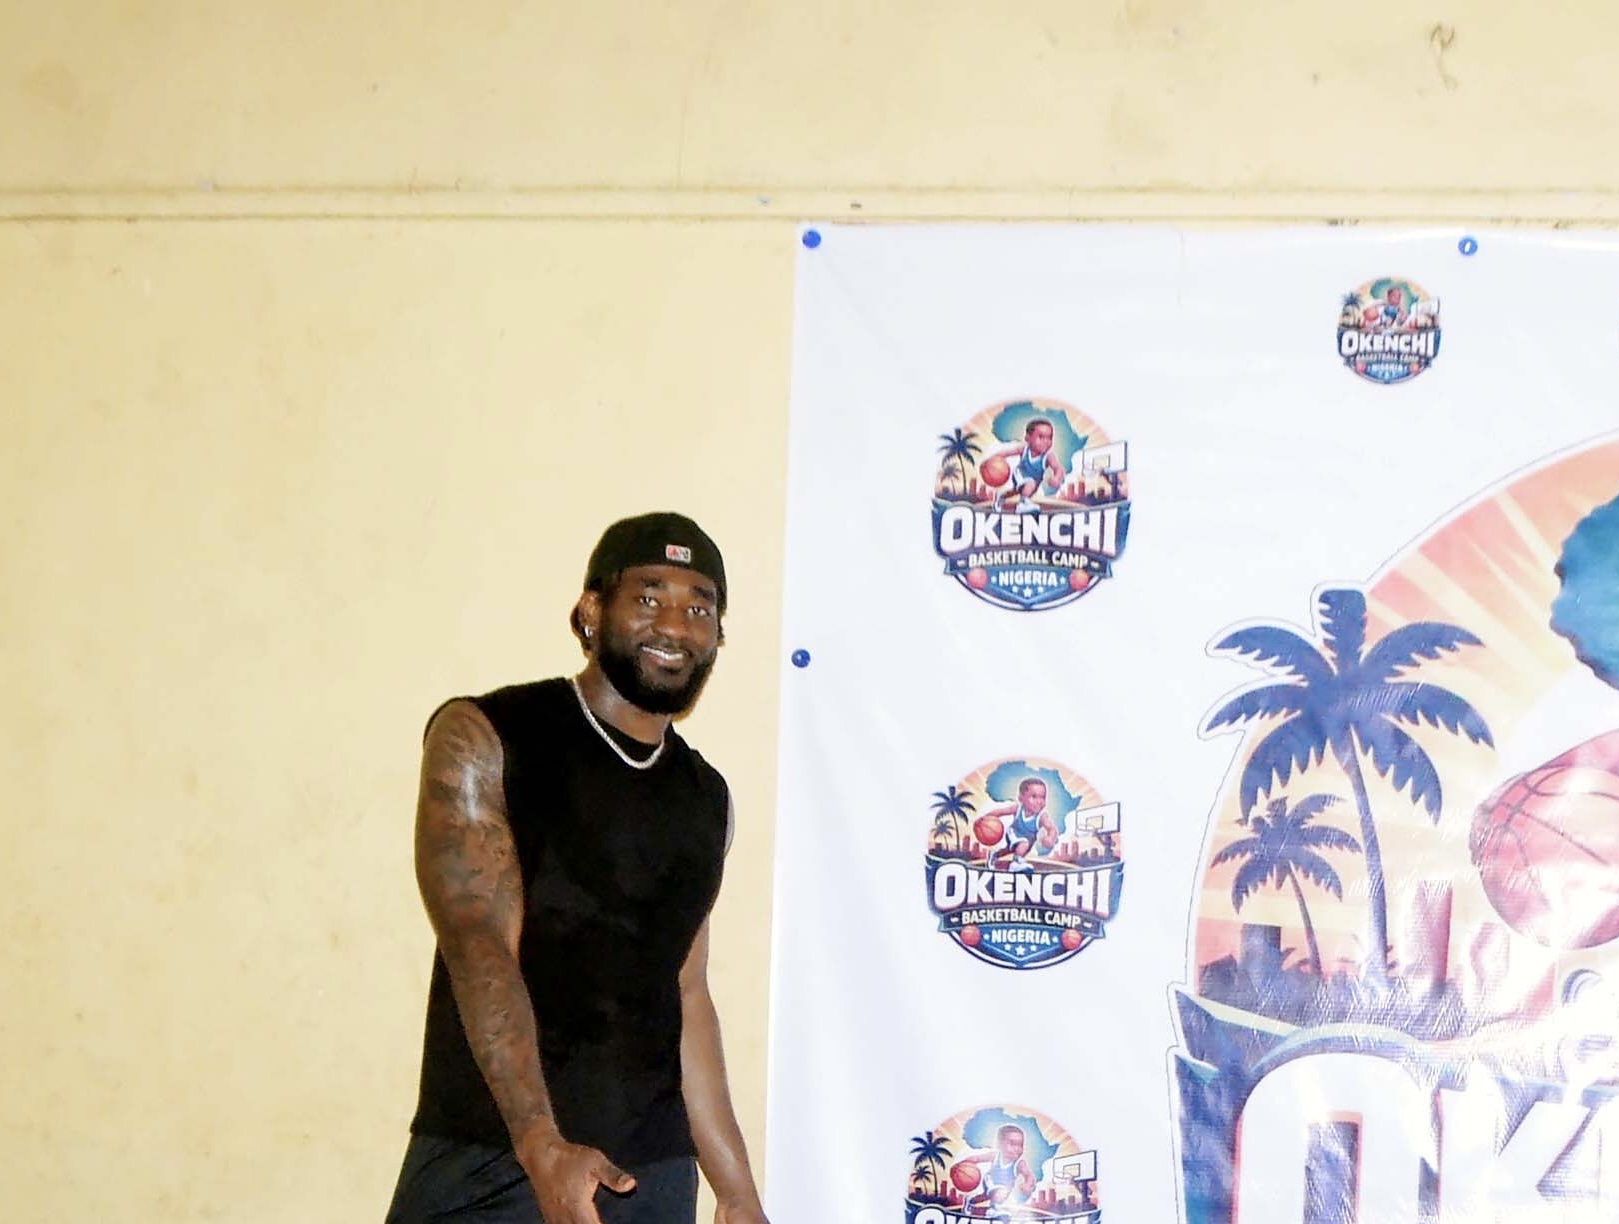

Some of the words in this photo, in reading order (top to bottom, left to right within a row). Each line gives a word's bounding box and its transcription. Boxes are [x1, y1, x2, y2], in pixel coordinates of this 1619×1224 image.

[1341, 330, 1434, 357] OKENCHI
[940, 506, 1118, 556] OKENCHI
[969, 550, 1048, 568] BASKETBALL
[1052, 552, 1088, 569] CAMP
[998, 572, 1058, 586] NIGERIA
[934, 864, 1111, 917] OKENCHI
[962, 908, 1040, 924] BASKETBALL
[1044, 911, 1081, 928] CAMP
[991, 929, 1050, 945] NIGERIA
